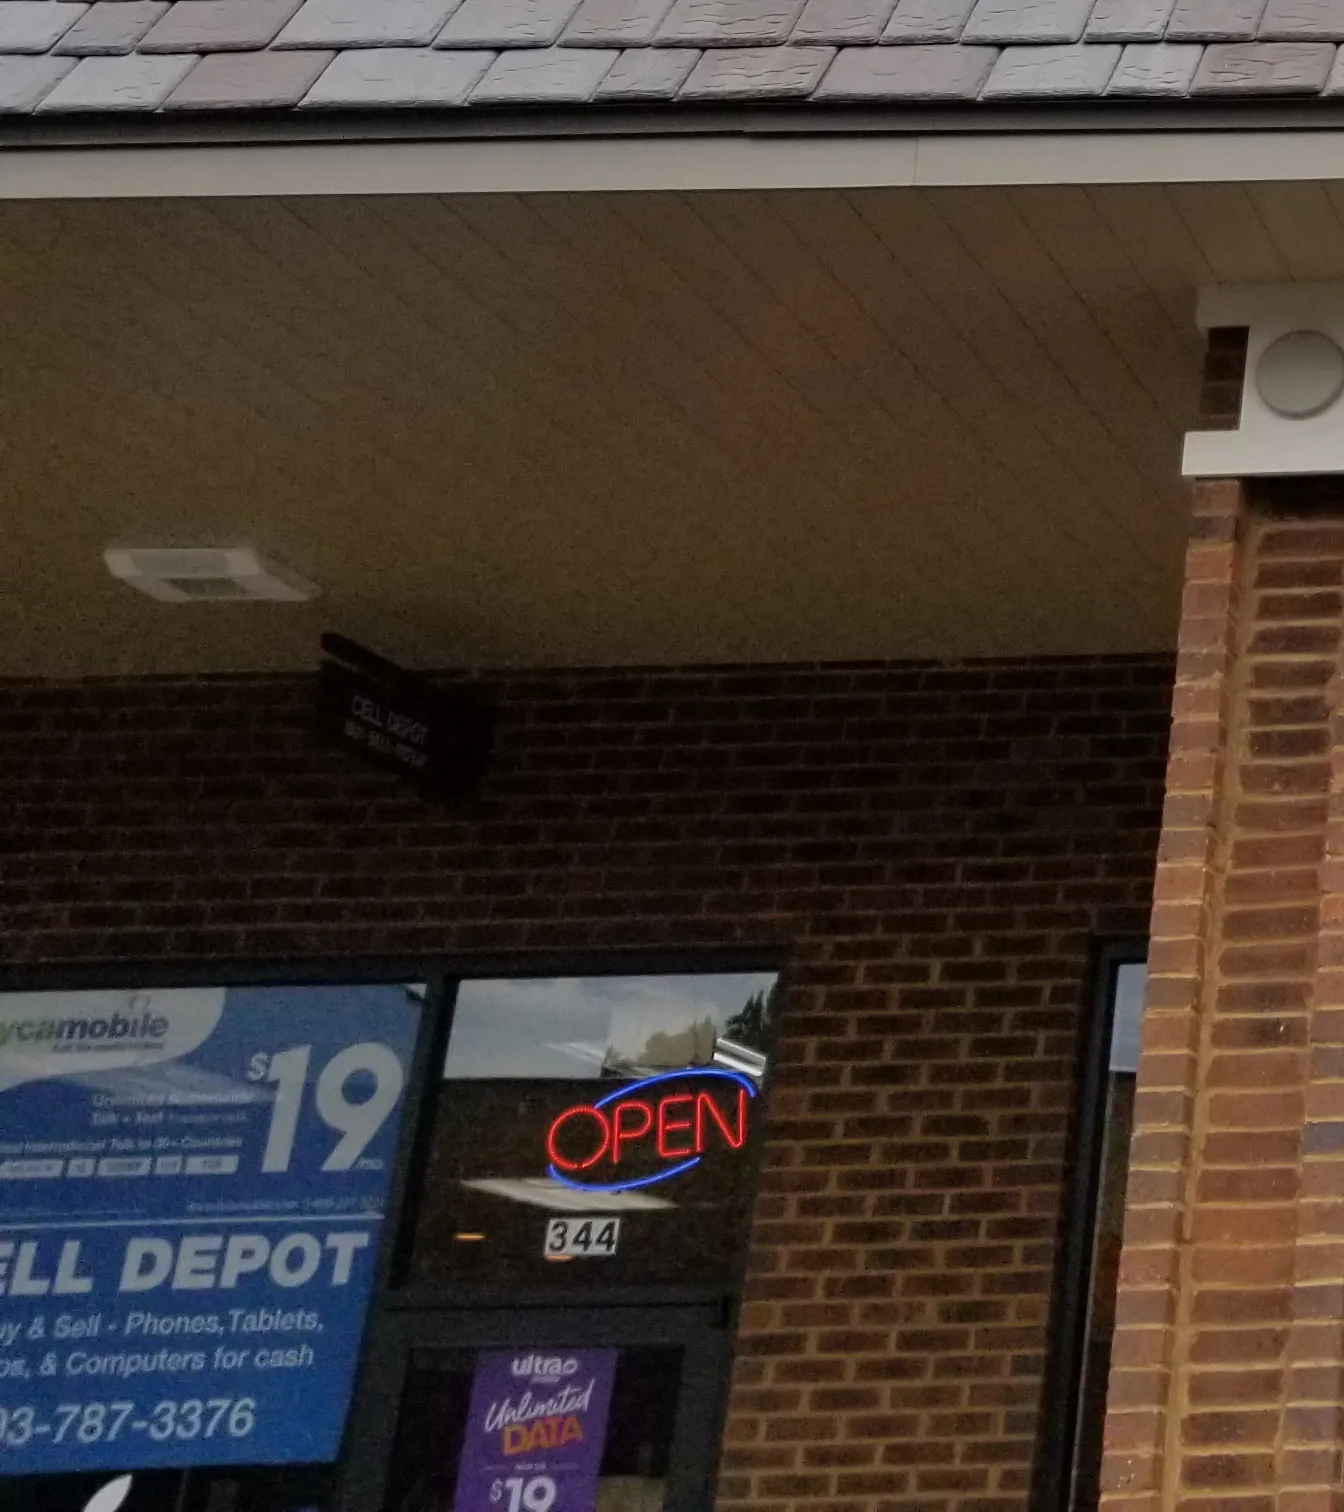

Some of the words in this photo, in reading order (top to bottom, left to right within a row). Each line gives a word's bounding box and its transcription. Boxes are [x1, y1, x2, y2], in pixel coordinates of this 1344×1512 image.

[546, 1088, 746, 1170] OPEN
[549, 1220, 616, 1253] 344
[119, 1233, 370, 1292] DEPOT
[27, 1317, 45, 1339] &
[53, 1313, 101, 1339] Sell
[124, 1310, 225, 1336] Phones,
[228, 1309, 324, 1333] Tablets,
[39, 1353, 58, 1376] &
[66, 1349, 205, 1378] Computers
[212, 1344, 246, 1370] for
[253, 1343, 314, 1367] cash
[484, 1378, 596, 1432] Unlimited
[503, 1416, 583, 1456] DATA
